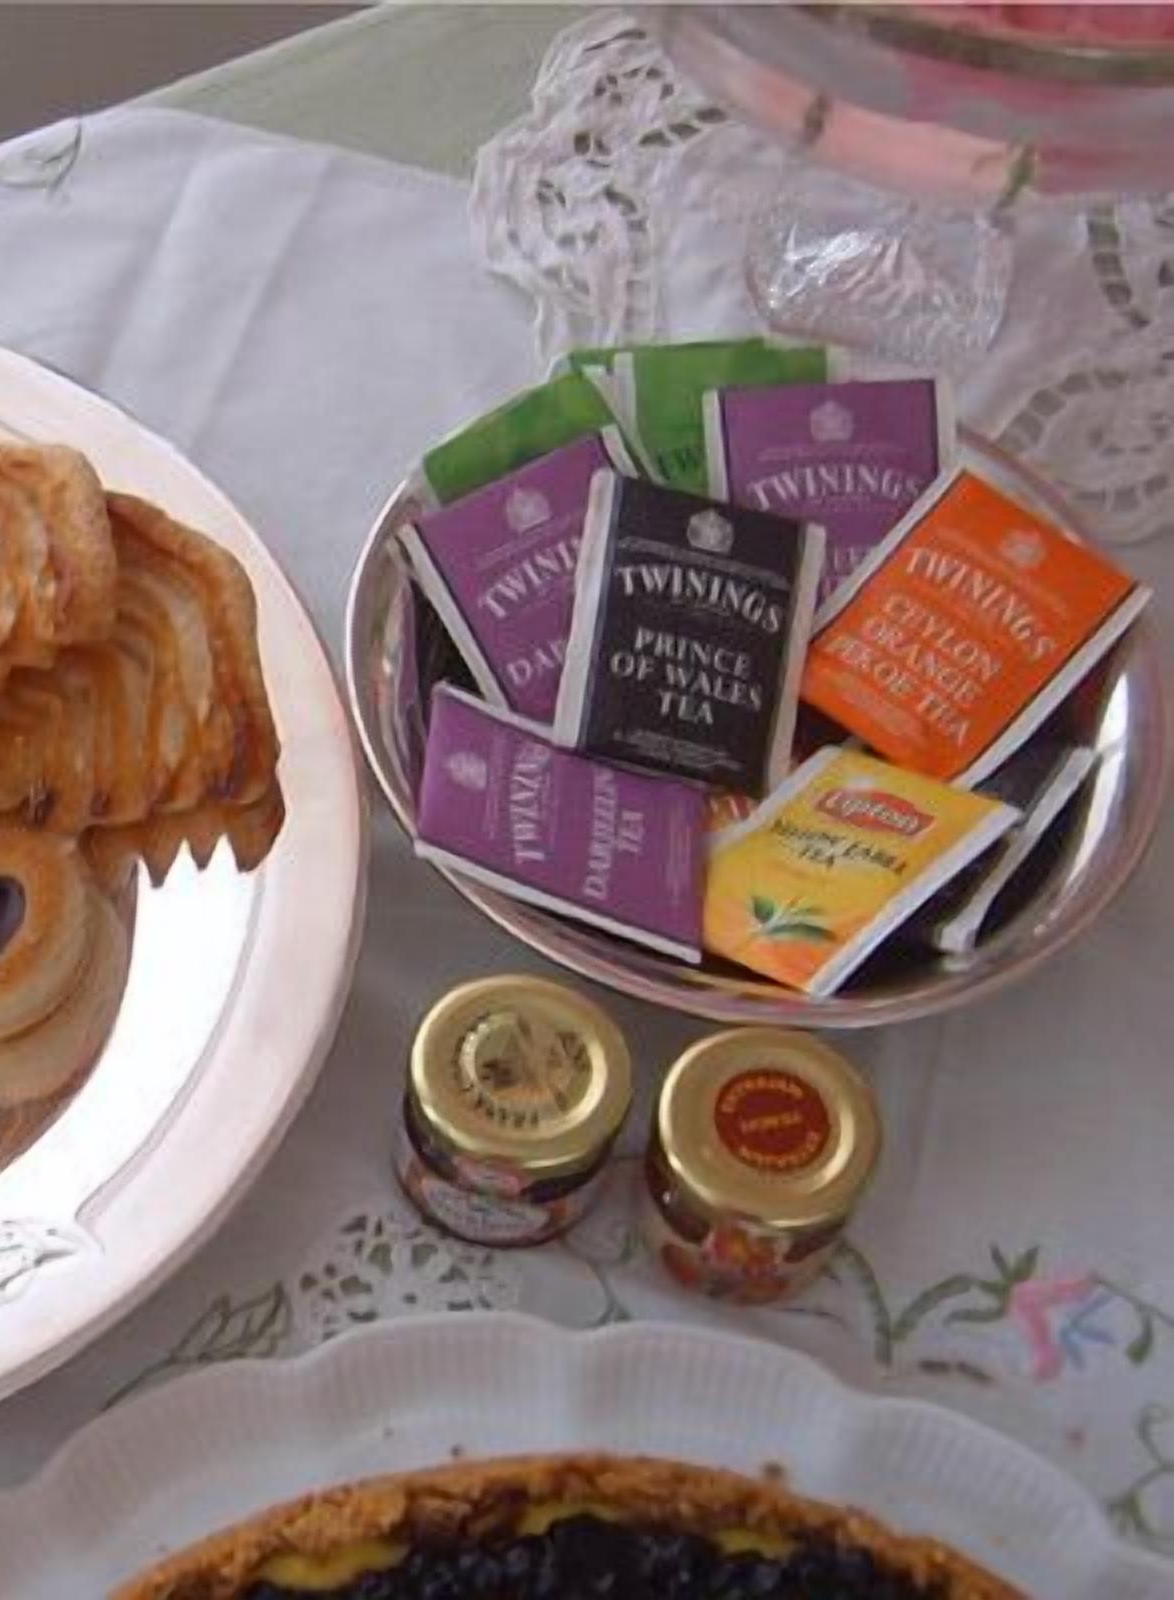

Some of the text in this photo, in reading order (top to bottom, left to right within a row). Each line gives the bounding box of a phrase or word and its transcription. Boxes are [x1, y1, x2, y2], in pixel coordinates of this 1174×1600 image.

[747, 463, 921, 512] TWININGS
[479, 538, 581, 619] TWINI
[617, 564, 779, 635] TWININGS
[906, 547, 1057, 662] TWININGS
[610, 651, 655, 681] OF
[665, 662, 763, 711] WALES
[634, 627, 751, 677] PRINCE
[659, 690, 714, 725] TEA
